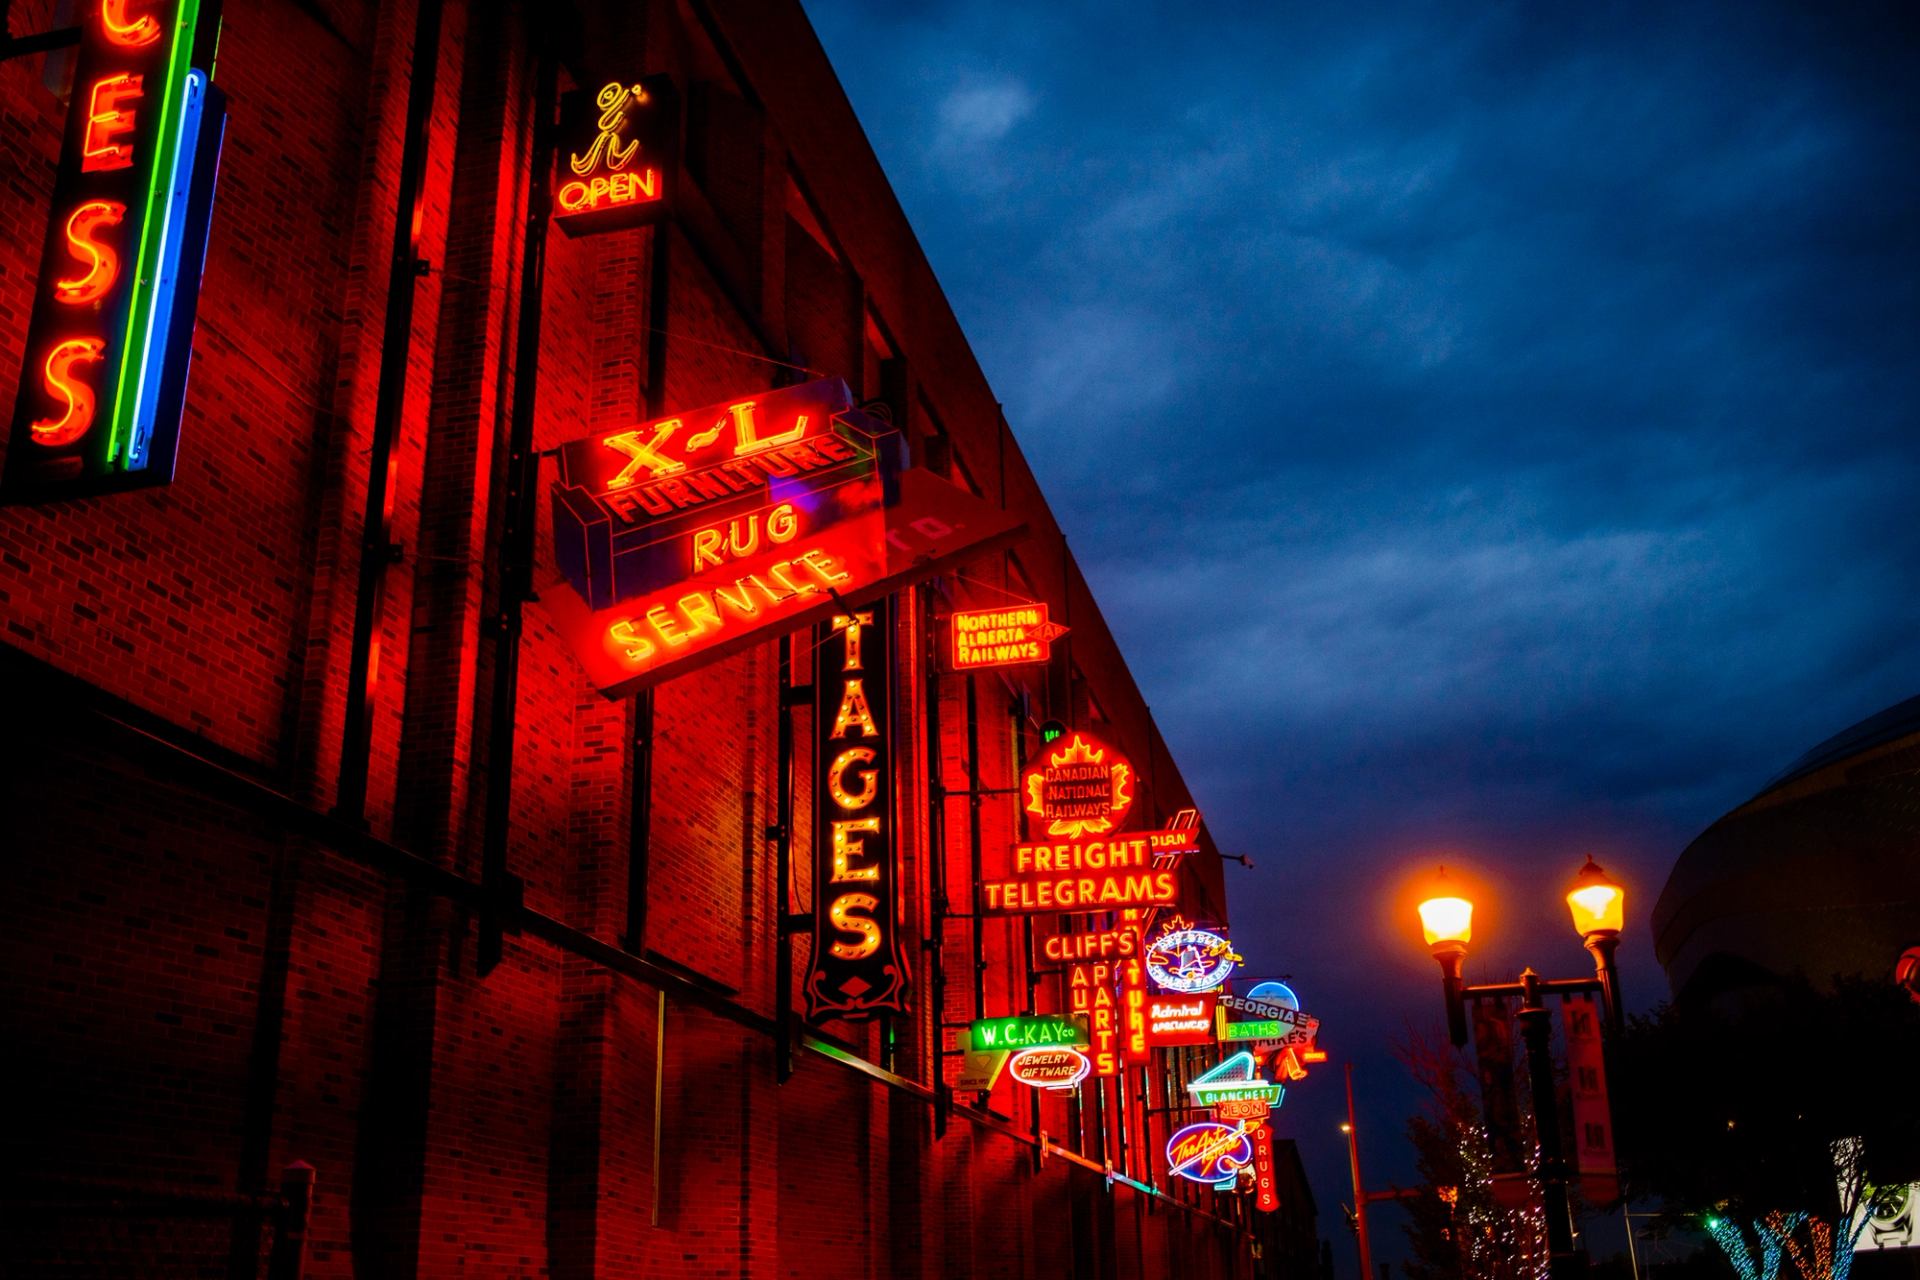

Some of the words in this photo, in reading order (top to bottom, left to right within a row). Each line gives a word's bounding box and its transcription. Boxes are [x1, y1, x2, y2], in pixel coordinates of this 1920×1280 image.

[559, 169, 654, 210] OPEN
[603, 401, 809, 490] X-L
[604, 434, 858, 525] FURNITURE
[693, 503, 798, 572] RUG
[609, 549, 849, 660] SERVICE
[957, 610, 1038, 631] NORTHERN
[958, 628, 1025, 648] ALBERTA
[959, 642, 1039, 663] RAILWAYS
[1045, 765, 1110, 783] CANADIAN
[1049, 784, 1110, 800] NATIONAL
[1045, 802, 1111, 819] RAILWAYS
[1017, 839, 1148, 873] FREIGHT
[984, 873, 1176, 910] TELEGRAMS
[1046, 931, 1134, 959] CLIFF'S
[1094, 965, 1115, 1075] PARTS
[1151, 999, 1204, 1019] Admiral
[1223, 998, 1296, 1023] GEORGIA
[1228, 1021, 1280, 1038] BATHS
[1018, 1053, 1070, 1066] JEWELRY
[1021, 1065, 1077, 1078] GIFTWARE
[1205, 1089, 1274, 1103] BLANCHETT
[1220, 1103, 1265, 1117] NEON
[1170, 1134, 1197, 1167] The
[1196, 1126, 1227, 1153] Art
[1200, 1139, 1242, 1177] Store
[1257, 1129, 1271, 1205] DRUGS
